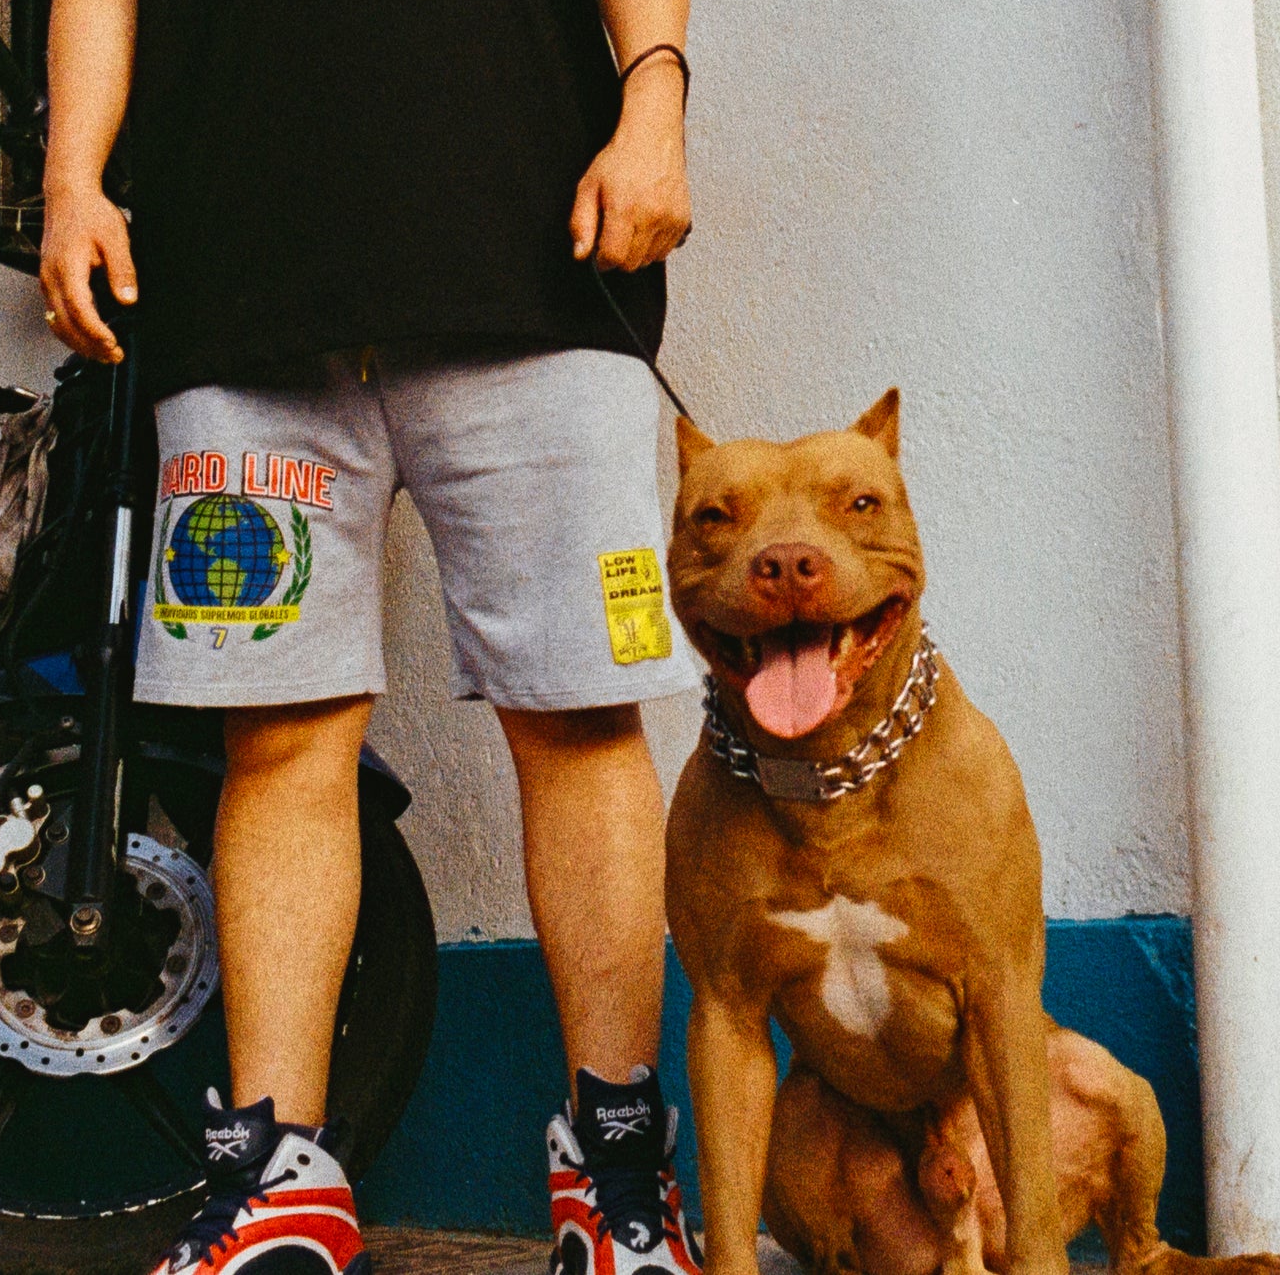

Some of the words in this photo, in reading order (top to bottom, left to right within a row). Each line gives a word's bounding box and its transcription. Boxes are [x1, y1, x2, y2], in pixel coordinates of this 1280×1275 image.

[241, 450, 337, 510] LINE
[604, 555, 635, 567] LOW
[606, 566, 637, 578] LIFE
[249, 608, 289, 620] GLOBALES
[210, 627, 228, 650] 7
[596, 1103, 651, 1122] Reebok
[205, 1126, 251, 1142] Reebok
